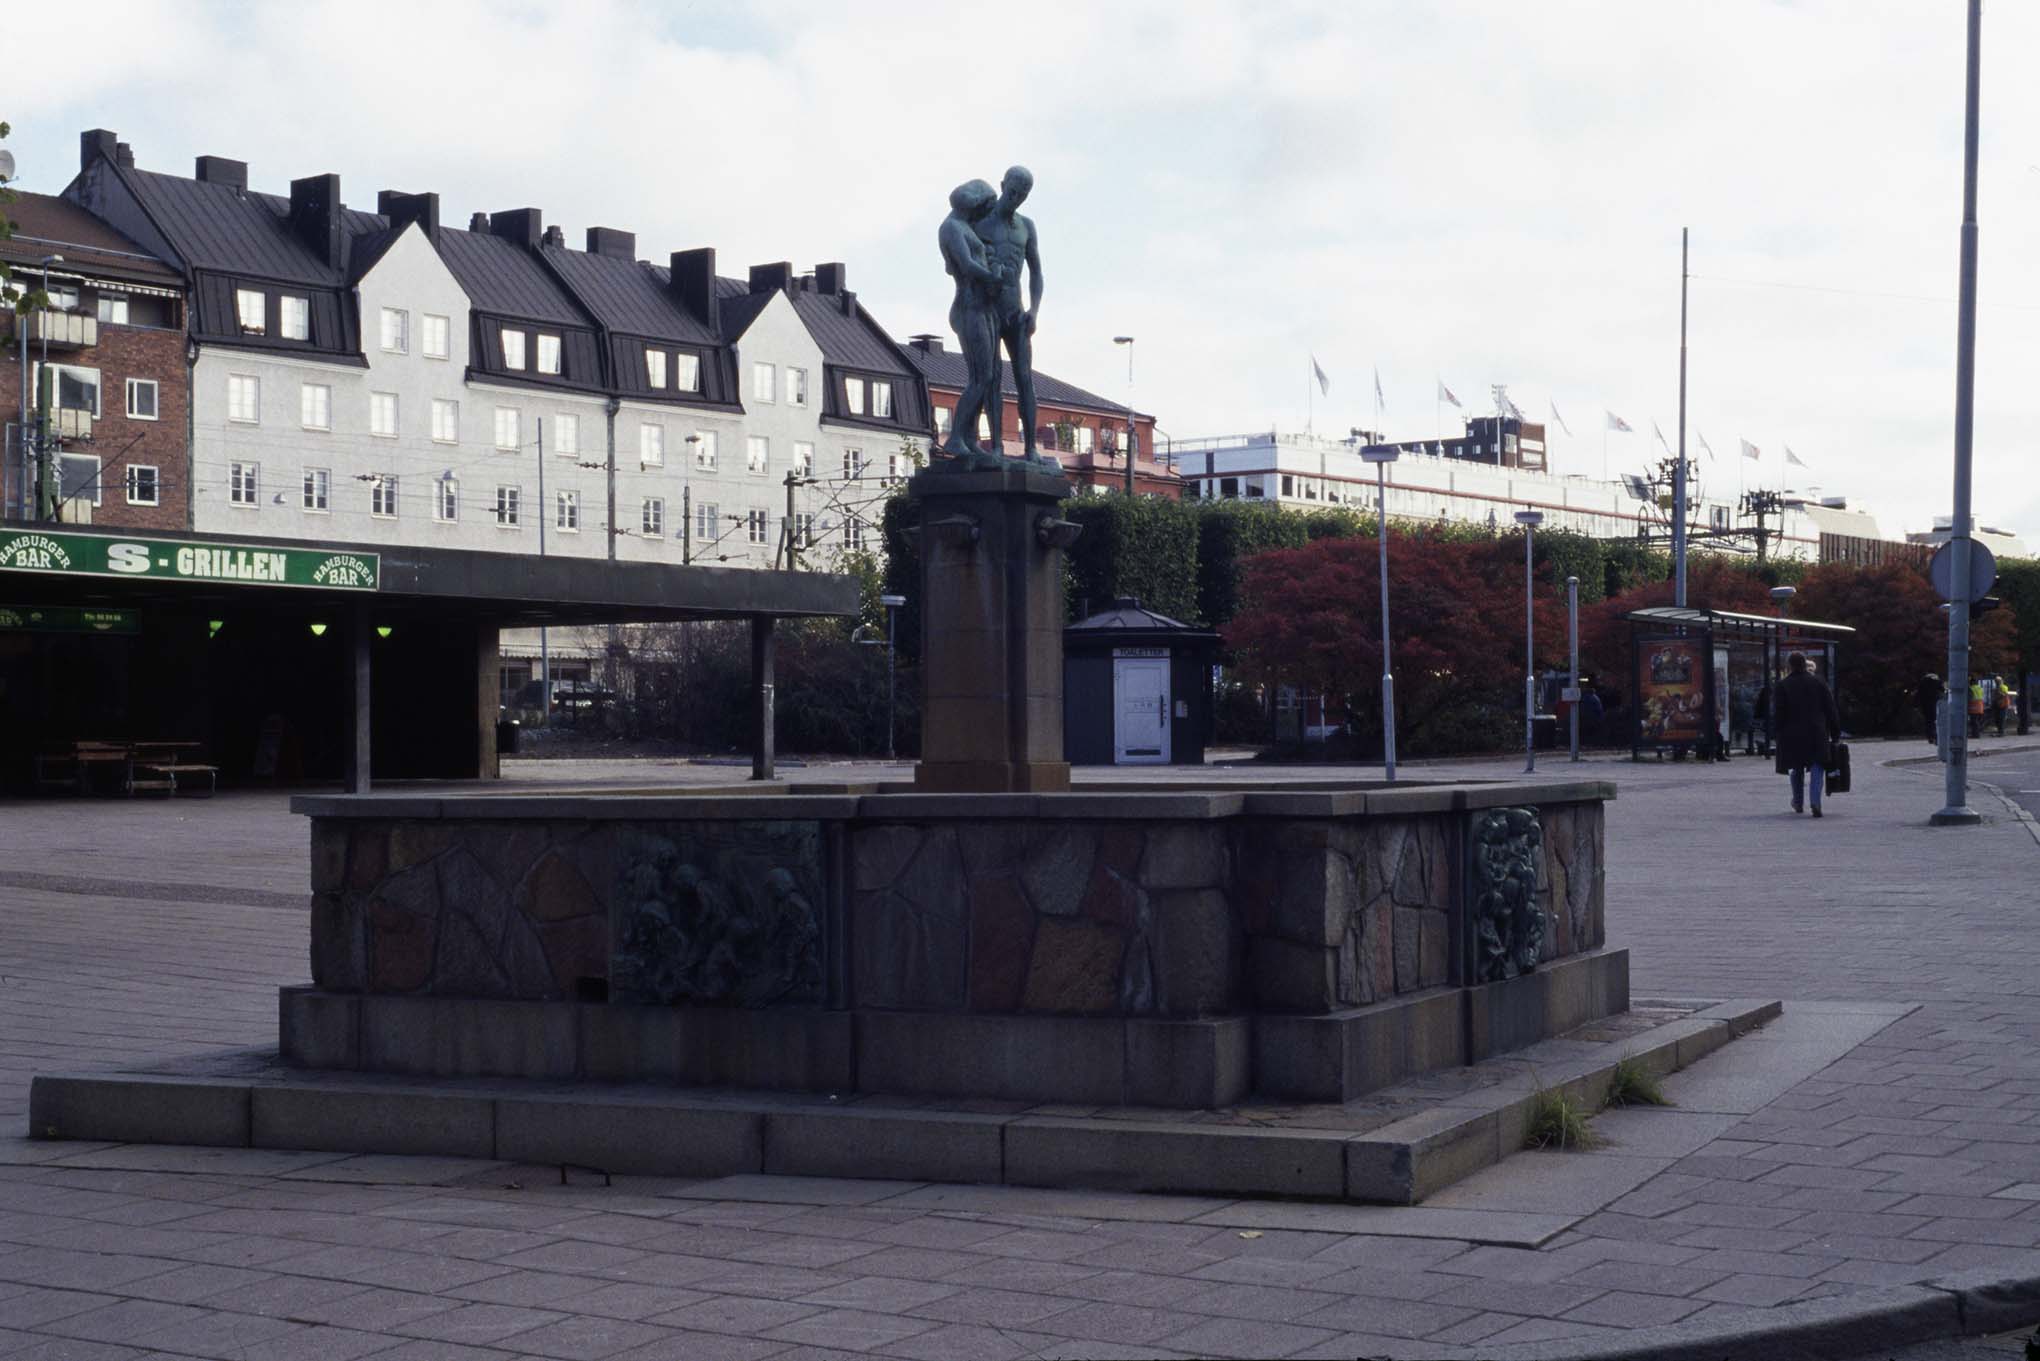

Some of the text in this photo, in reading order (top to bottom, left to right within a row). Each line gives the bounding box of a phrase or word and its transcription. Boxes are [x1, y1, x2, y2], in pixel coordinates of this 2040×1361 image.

[0, 535, 71, 569] HAMBURGER
[16, 548, 52, 568] BAR
[313, 555, 374, 586] HAMBURGER
[329, 567, 358, 586] BAR
